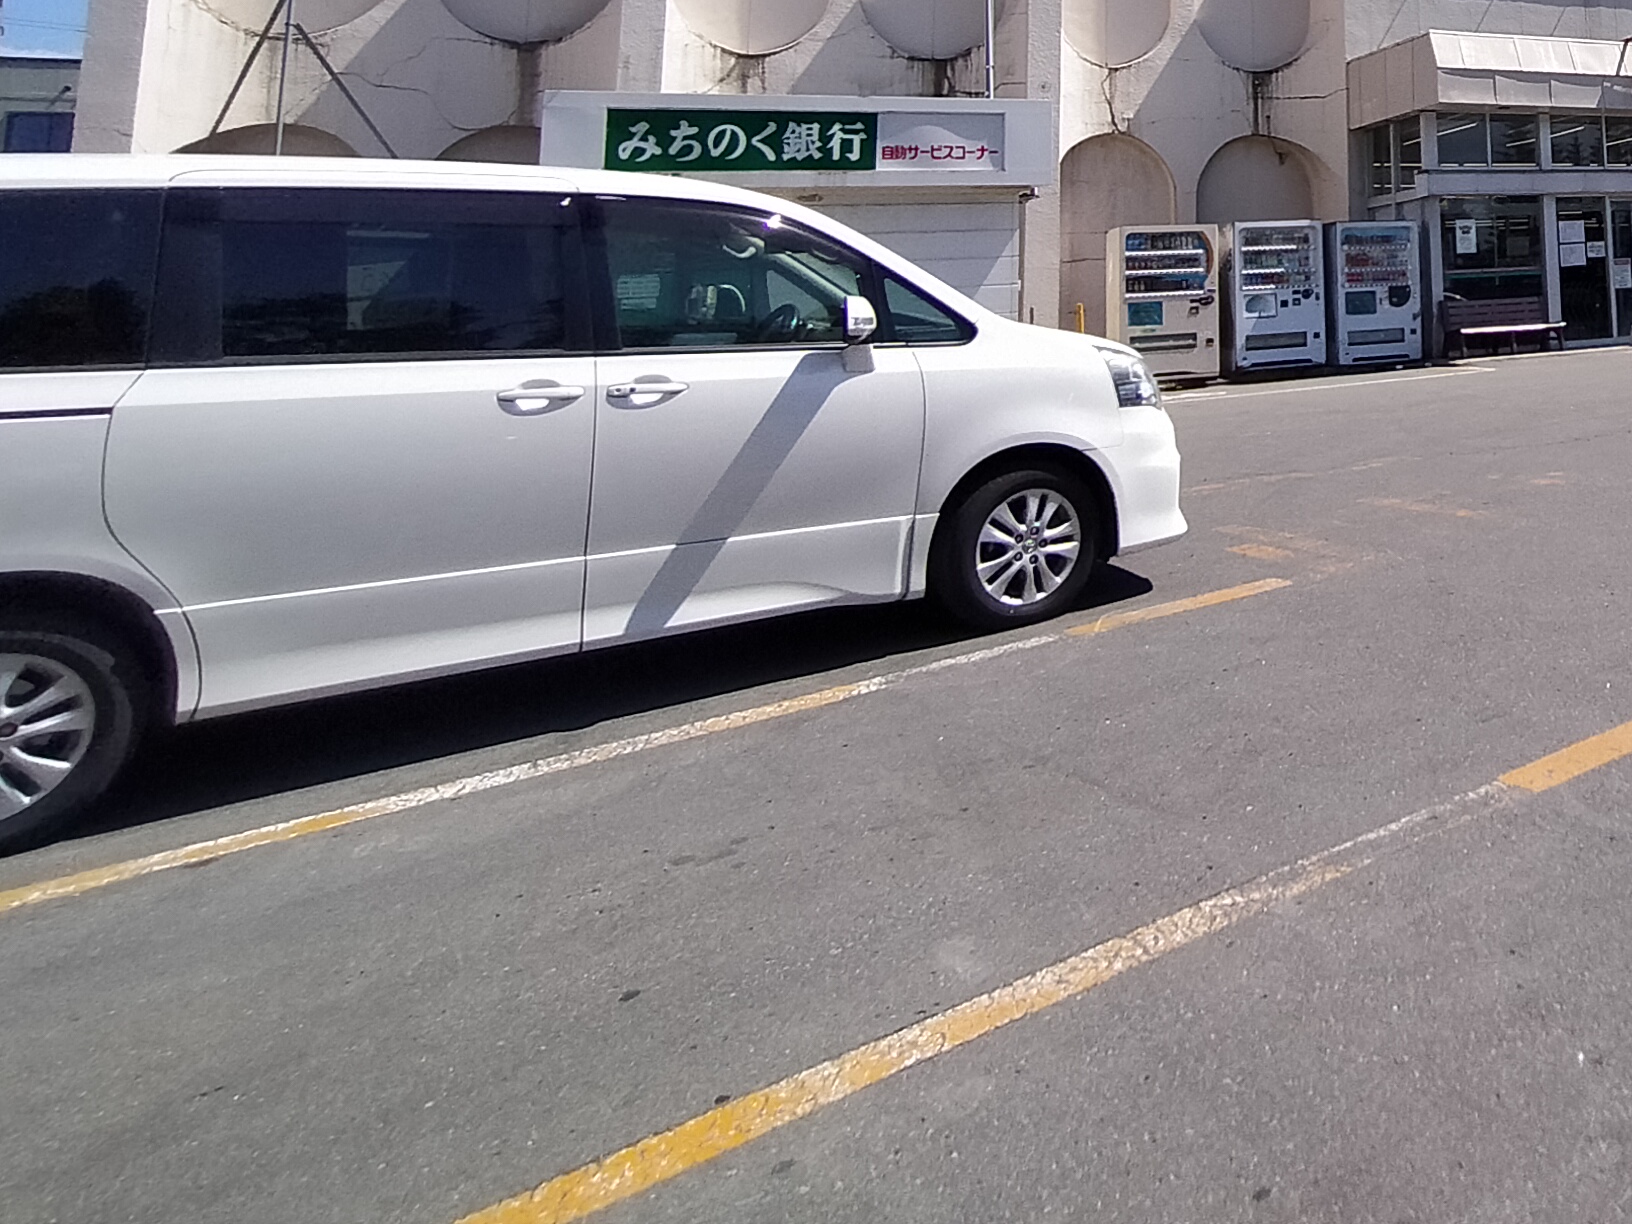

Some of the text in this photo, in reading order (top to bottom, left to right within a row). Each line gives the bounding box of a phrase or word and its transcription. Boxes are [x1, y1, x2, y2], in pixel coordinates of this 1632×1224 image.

[617, 120, 867, 162] みちのく銀行
[881, 145, 999, 160] 自動サービスコーナー
